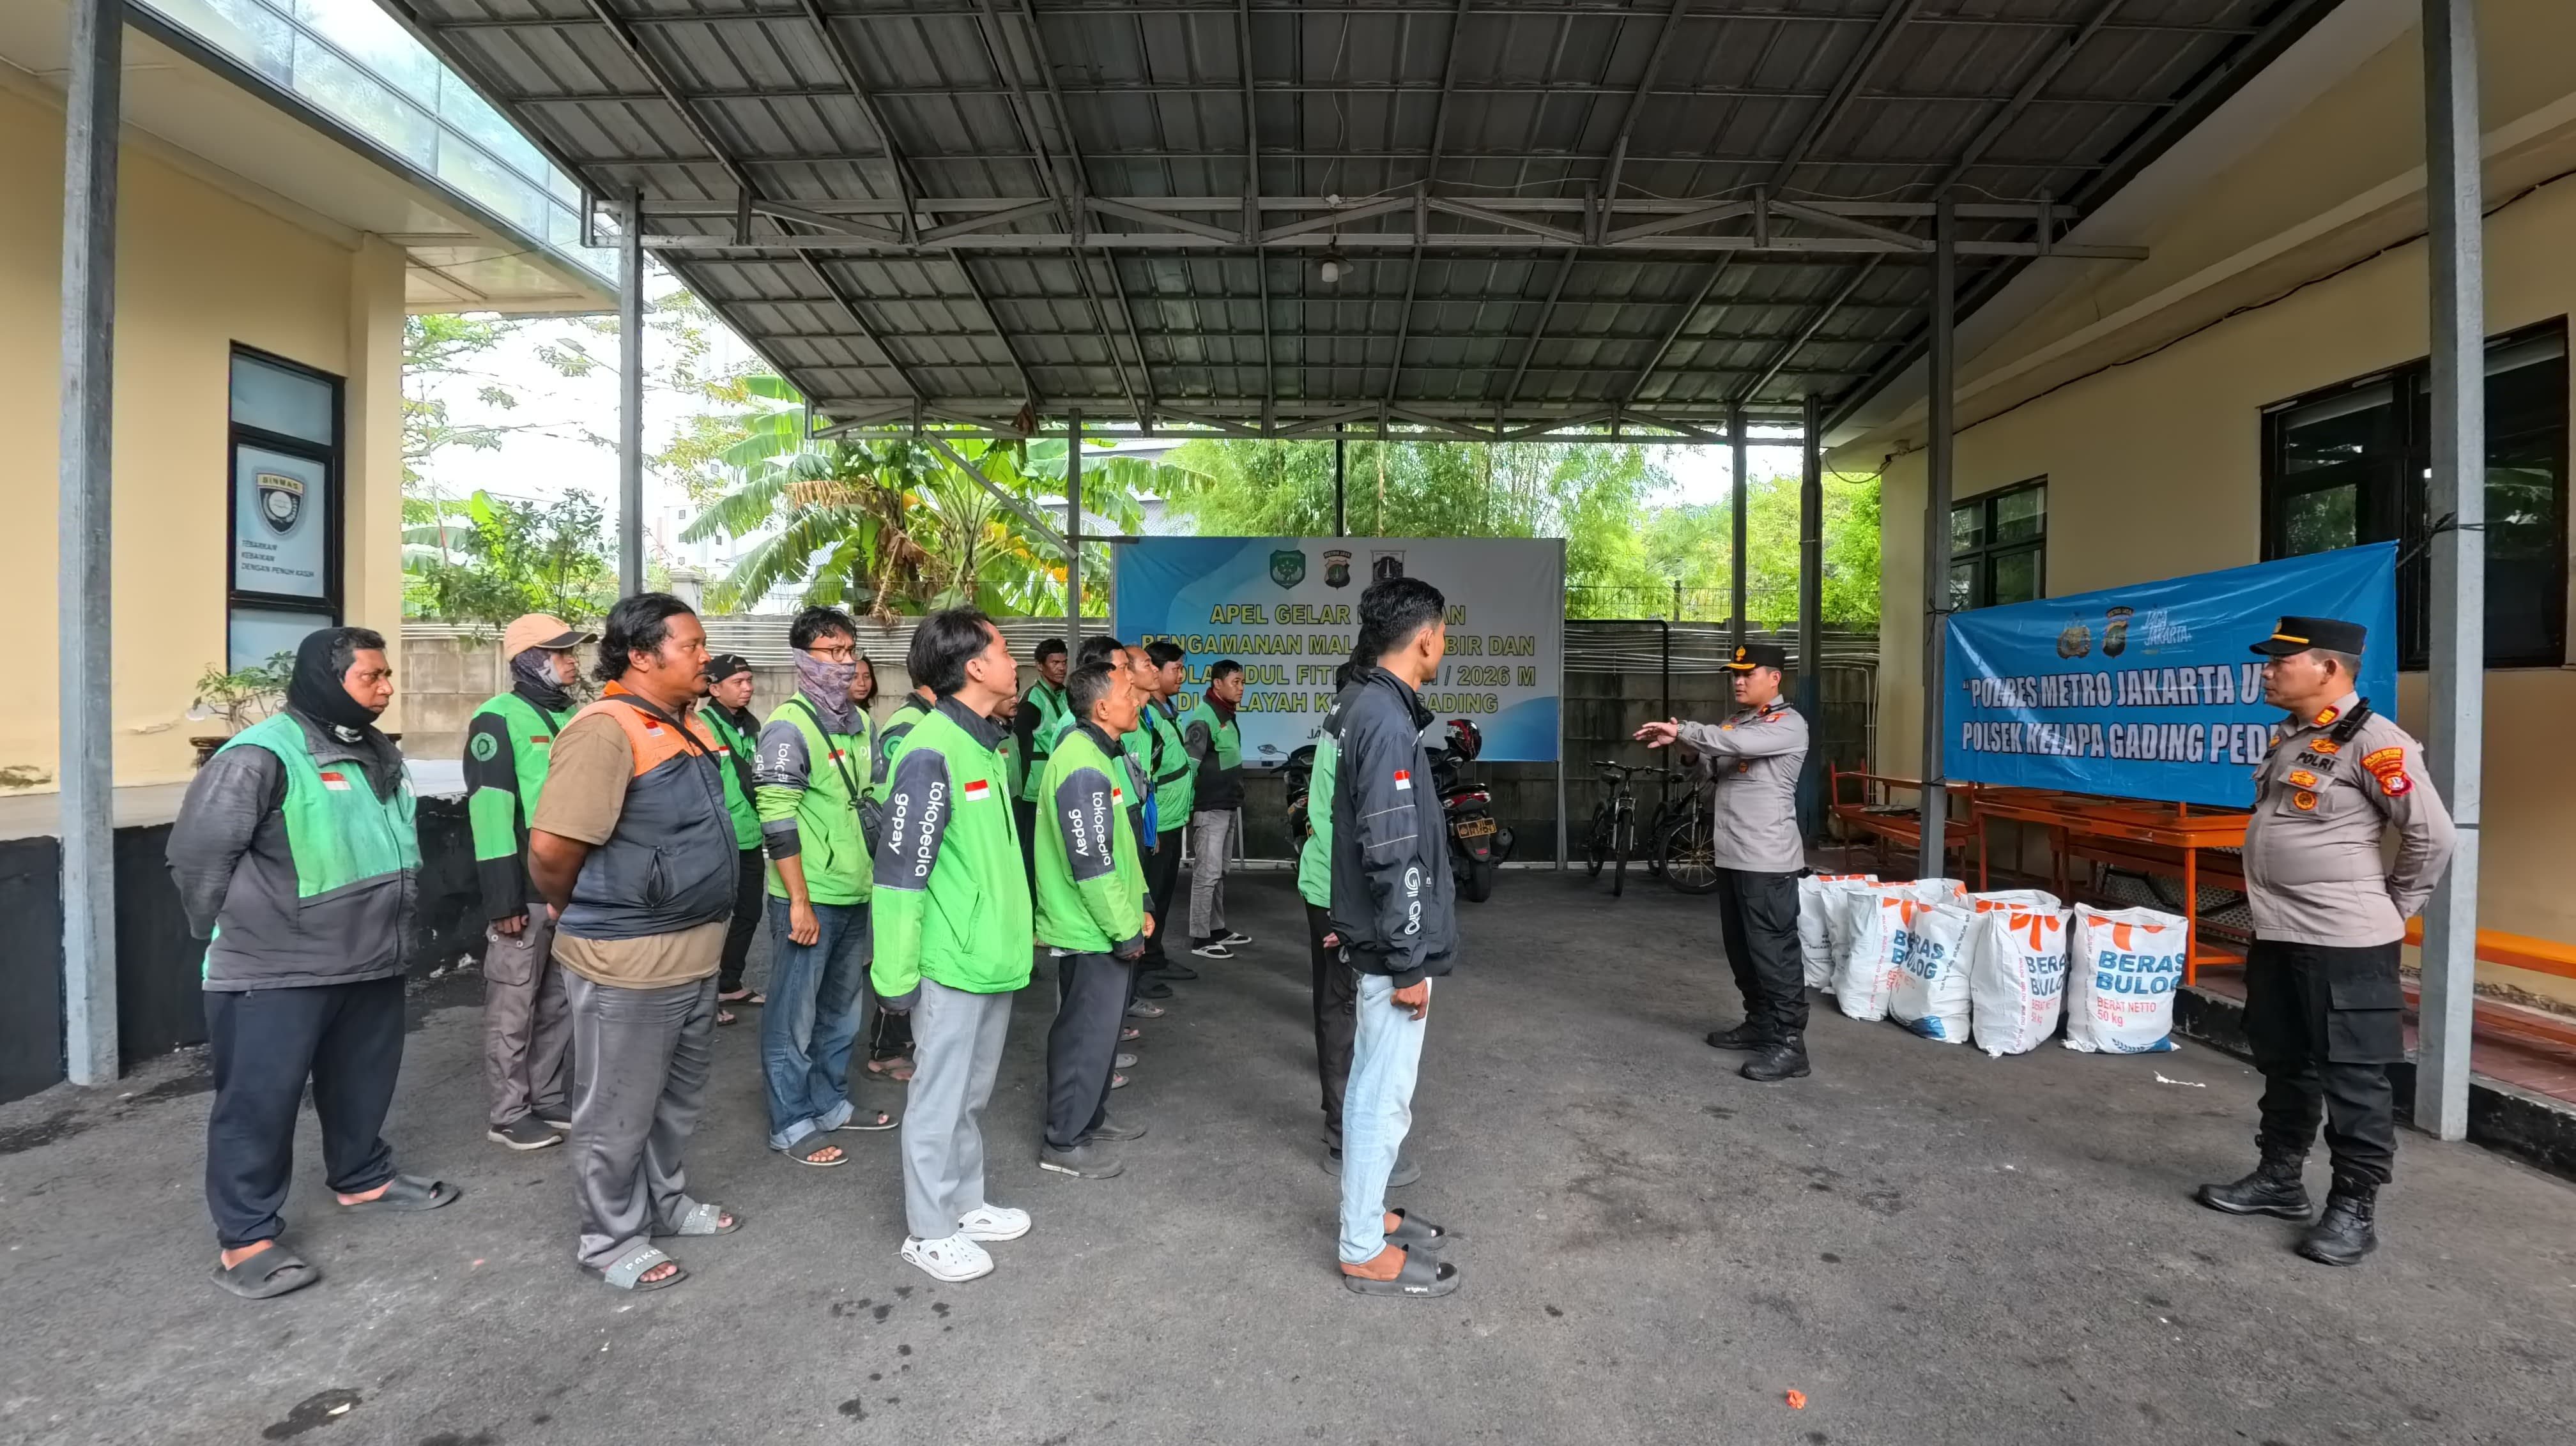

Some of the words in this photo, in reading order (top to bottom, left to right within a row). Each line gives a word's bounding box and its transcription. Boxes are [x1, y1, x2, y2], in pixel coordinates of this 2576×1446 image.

[263, 476, 299, 489] BINMAS
[1210, 604, 1268, 625] APEL
[1275, 604, 1351, 625] GELAR
[1309, 634, 1354, 655] MAL
[1489, 635, 1535, 656] DAN
[1241, 664, 1290, 685] DUL
[1296, 665, 1340, 685] FIT
[1457, 666, 1510, 686] 2026
[1518, 666, 1535, 687] M
[2041, 671, 2112, 707] METRO
[2117, 664, 2235, 706] JAKARTA
[1235, 692, 1307, 712] LAYAH
[1963, 721, 2024, 754] POLSEK
[2026, 722, 2106, 758] KELAPA
[2108, 722, 2204, 763] GADING
[2210, 723, 2278, 766] PED
[2296, 752, 2334, 772] POLRI
[888, 793, 909, 855] gopay
[914, 781, 946, 877] tokopedia
[1068, 809, 1089, 856] gopay
[1092, 791, 1111, 866] tokopedia
[2025, 954, 2066, 974] BERA
[2098, 950, 2185, 973] BERAS
[2030, 975, 2064, 996] BULO
[2097, 996, 2125, 1012] BERAT
[2128, 1001, 2157, 1013] NETTO
[2097, 1010, 2109, 1021] 50
[2112, 1013, 2124, 1028] kg
